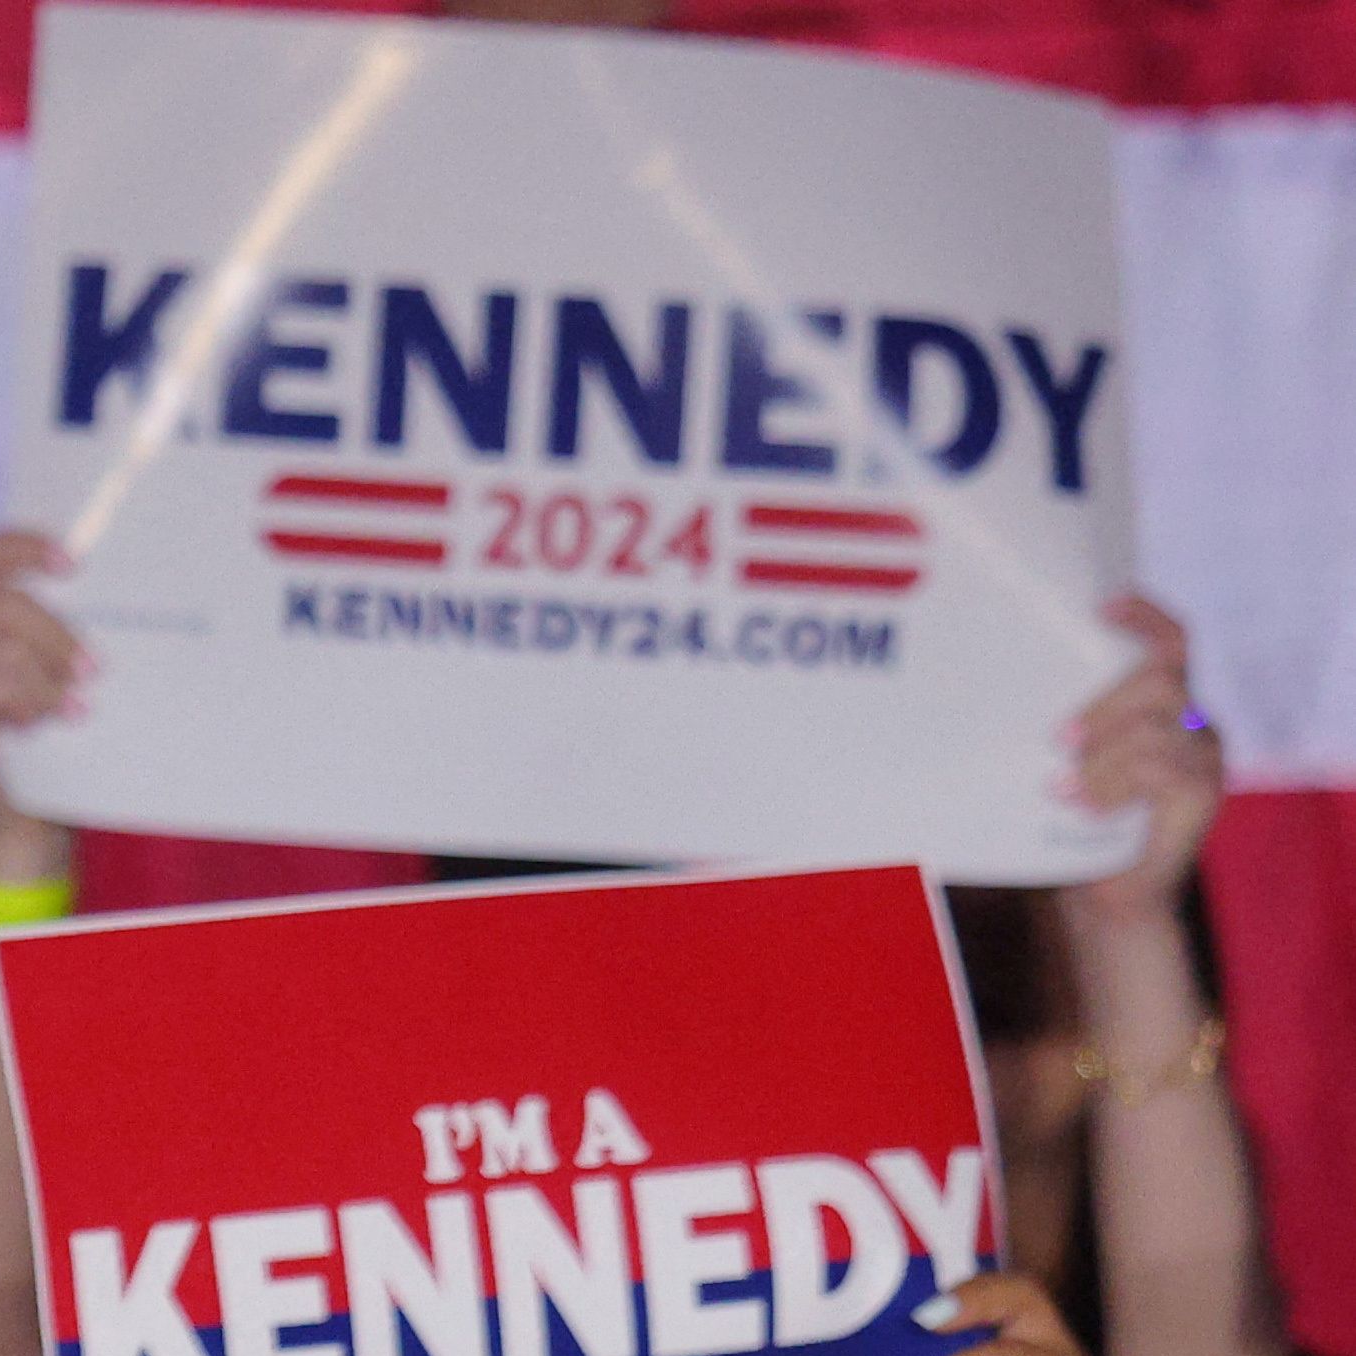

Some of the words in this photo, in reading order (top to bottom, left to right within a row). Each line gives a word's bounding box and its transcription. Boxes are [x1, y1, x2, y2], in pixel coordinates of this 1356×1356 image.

[51, 258, 1118, 496] KENNEDY
[479, 484, 716, 579] 2024
[281, 583, 901, 668] KENNEDY24.COM
[413, 1093, 561, 1185] I'M
[573, 1087, 653, 1169] A
